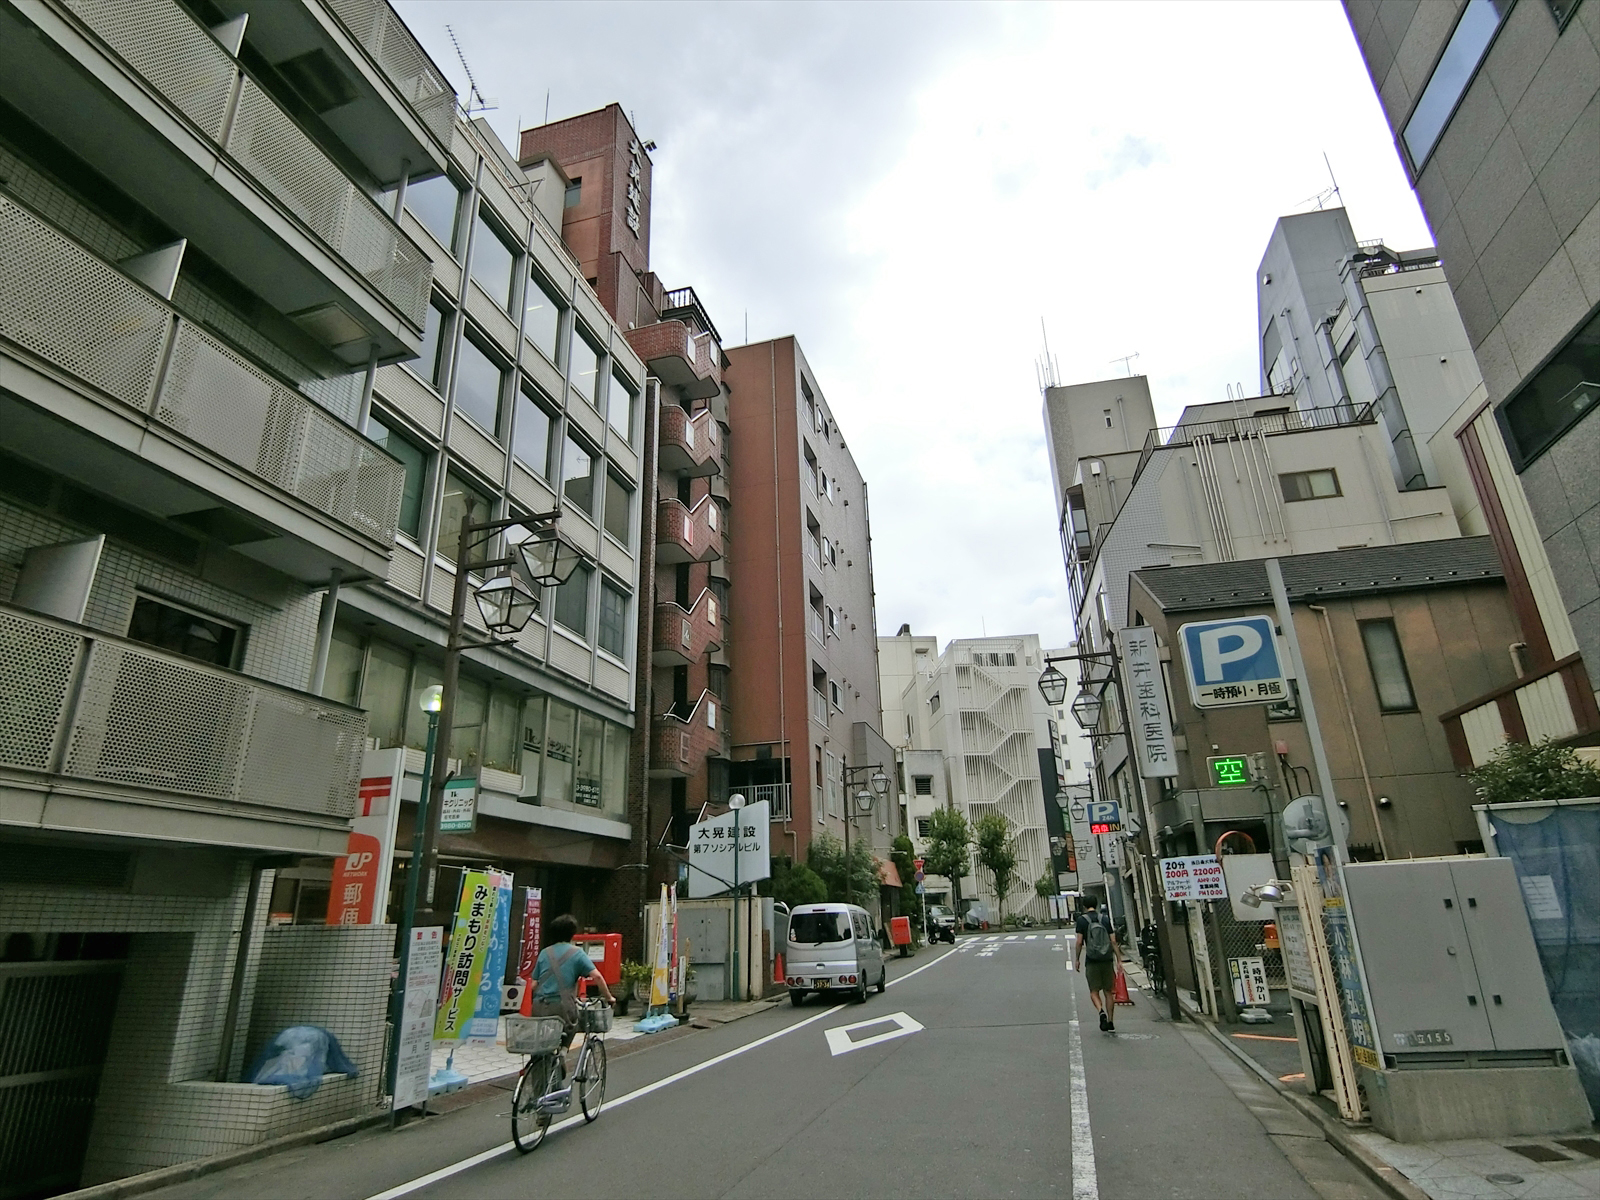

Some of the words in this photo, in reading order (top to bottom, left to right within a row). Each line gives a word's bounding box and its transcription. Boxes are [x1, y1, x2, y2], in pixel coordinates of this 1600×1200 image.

[1199, 625, 1262, 682] P
[1129, 640, 1167, 763] 新井歯科医院
[1215, 758, 1246, 784] 空
[1109, 824, 1120, 832] IN
[1165, 861, 1185, 870] 20分
[1165, 869, 1188, 878] 200円
[1193, 867, 1220, 876] 2200円
[339, 882, 363, 925] 郵便
[444, 885, 488, 1031] みまもり訪問サービス
[1250, 961, 1266, 1001] 一時預かり
[1334, 925, 1368, 1046] 小林弘明
